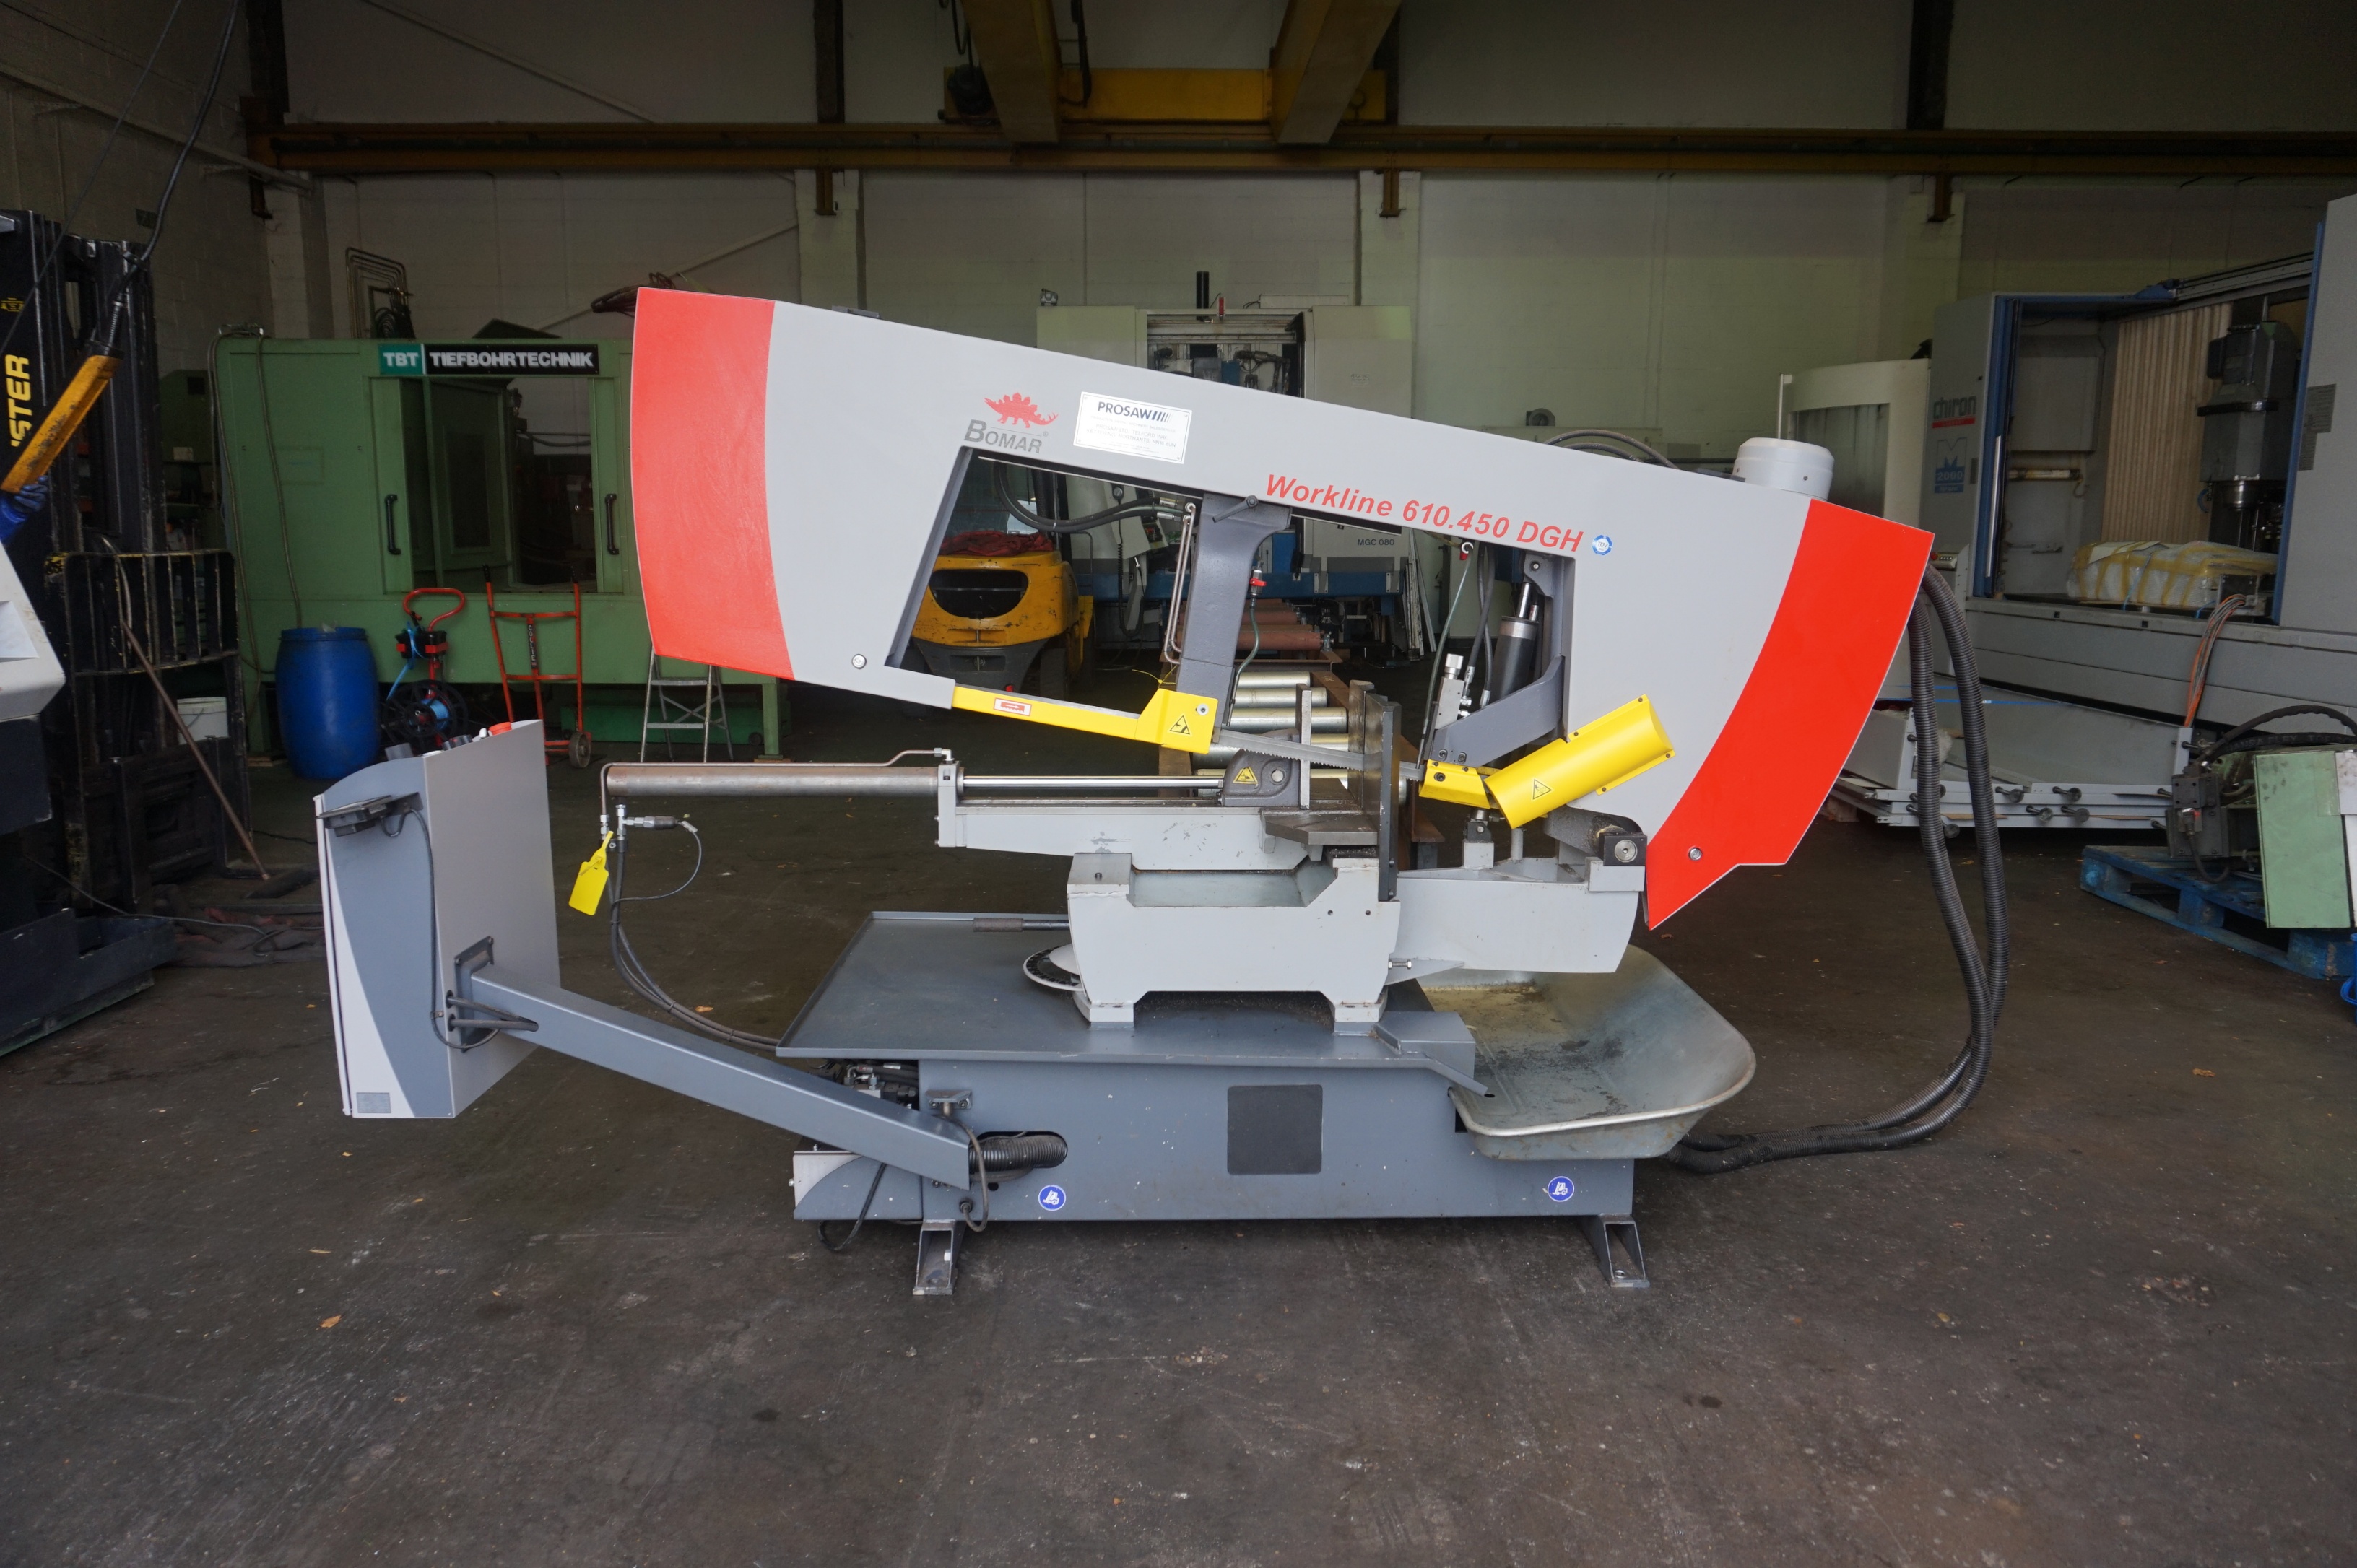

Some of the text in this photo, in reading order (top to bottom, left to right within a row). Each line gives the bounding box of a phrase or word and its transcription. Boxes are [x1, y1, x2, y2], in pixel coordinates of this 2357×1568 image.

[383, 351, 594, 367] TBT TIEFBOHRTECHNIK
[5, 354, 32, 447] STER
[1098, 401, 1153, 419] PROSAW
[964, 419, 1042, 453] BOMAR
[1937, 470, 1963, 482] 2000
[1267, 474, 1584, 552] Workline 610.450 DGH
